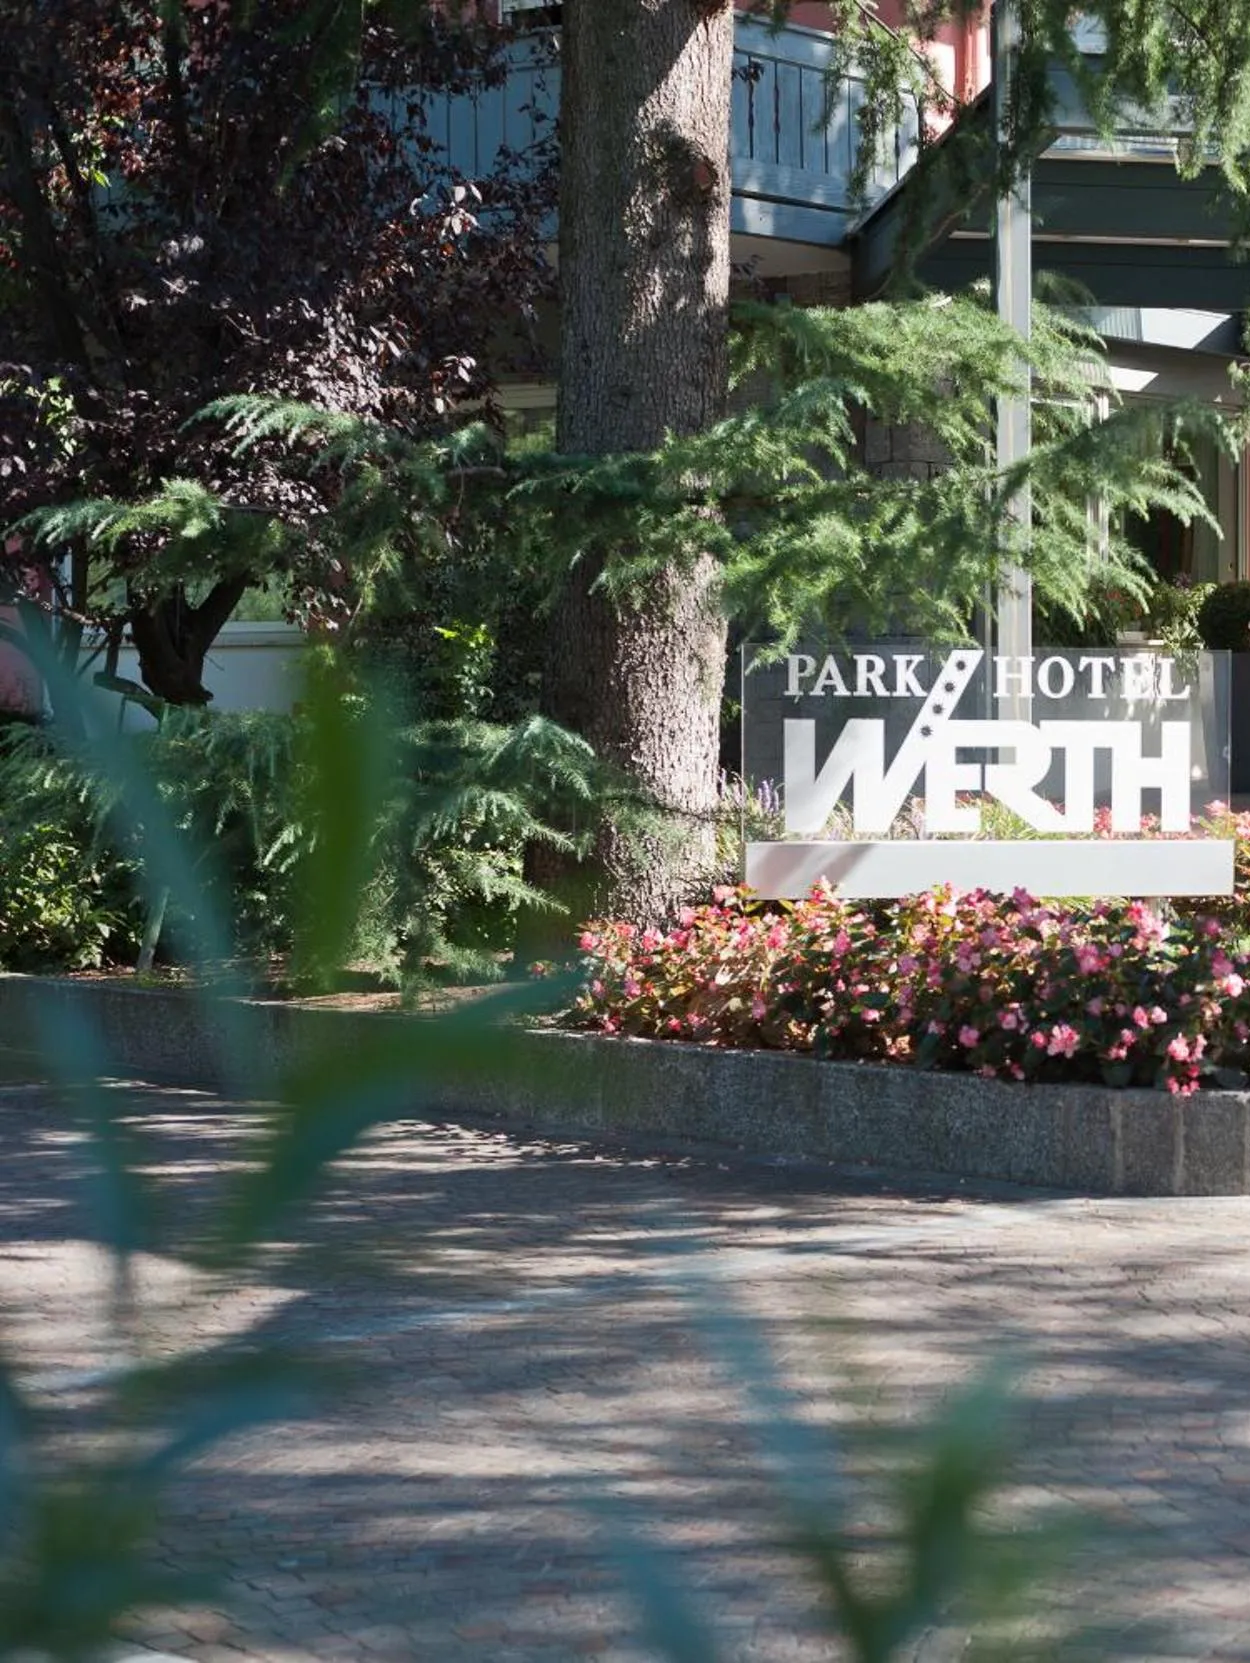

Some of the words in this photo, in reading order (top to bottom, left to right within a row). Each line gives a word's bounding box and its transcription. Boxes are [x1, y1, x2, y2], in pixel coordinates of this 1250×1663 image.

[784, 655, 928, 697] PARK
[993, 656, 1191, 699] HOTEL
[784, 650, 1191, 832] WERTH
